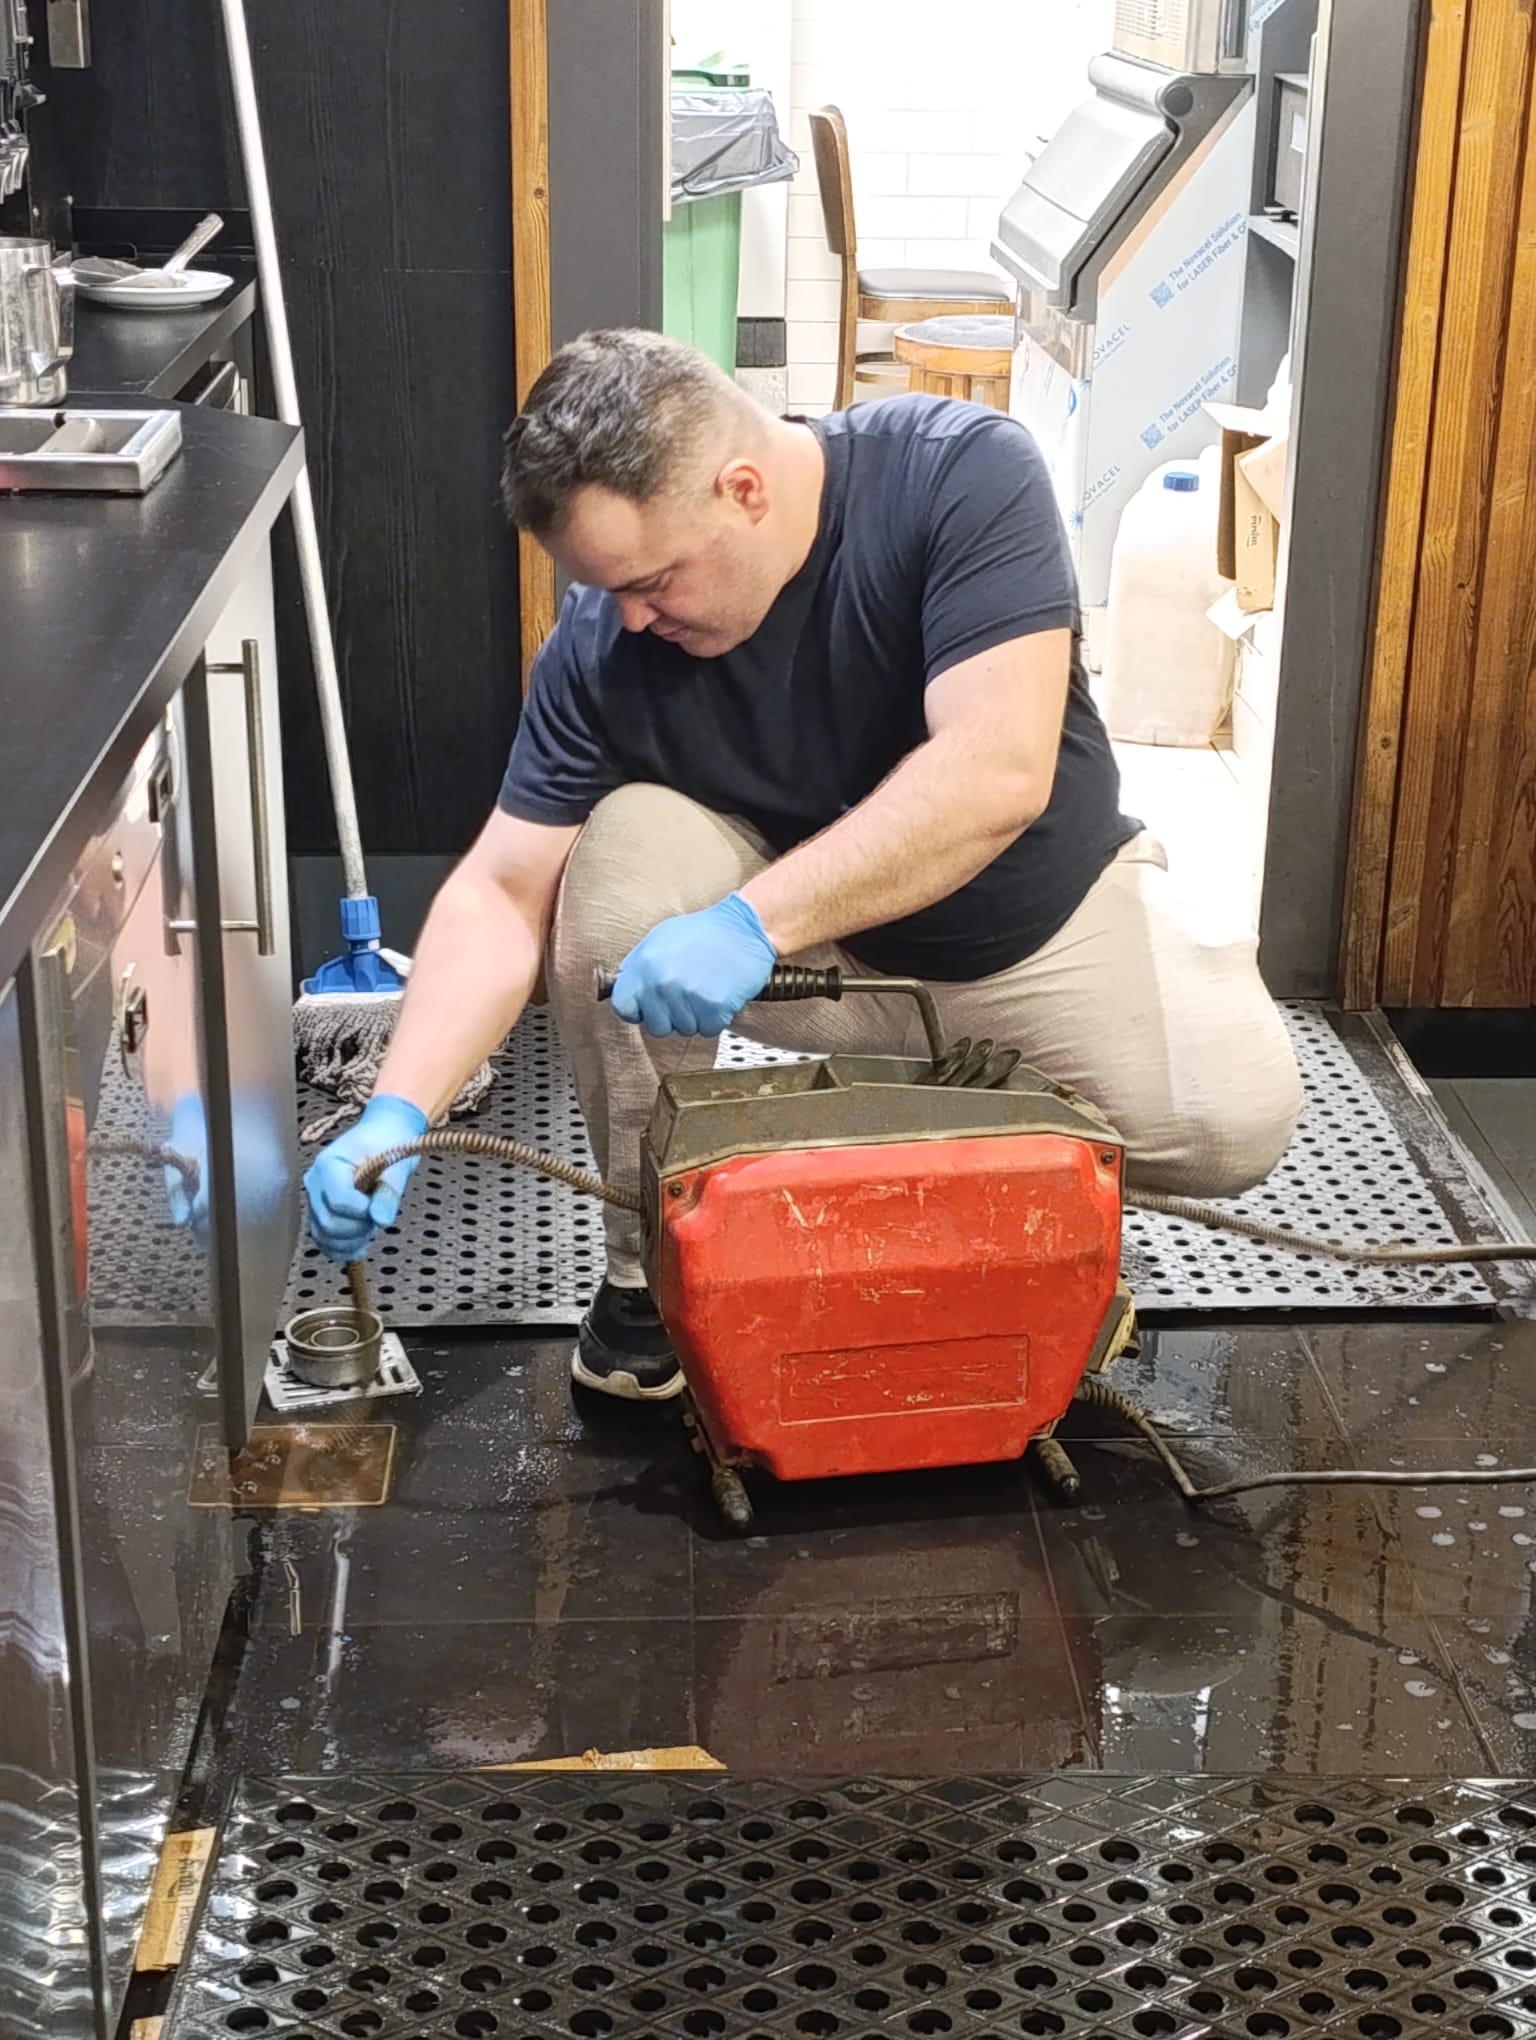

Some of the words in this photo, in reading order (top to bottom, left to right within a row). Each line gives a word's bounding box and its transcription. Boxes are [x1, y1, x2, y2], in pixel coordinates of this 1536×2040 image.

[1210, 212, 1242, 241] Solution
[1188, 255, 1215, 281] LASER
[1092, 324, 1131, 361] OVACEL
[1084, 464, 1121, 501] OVACEL
